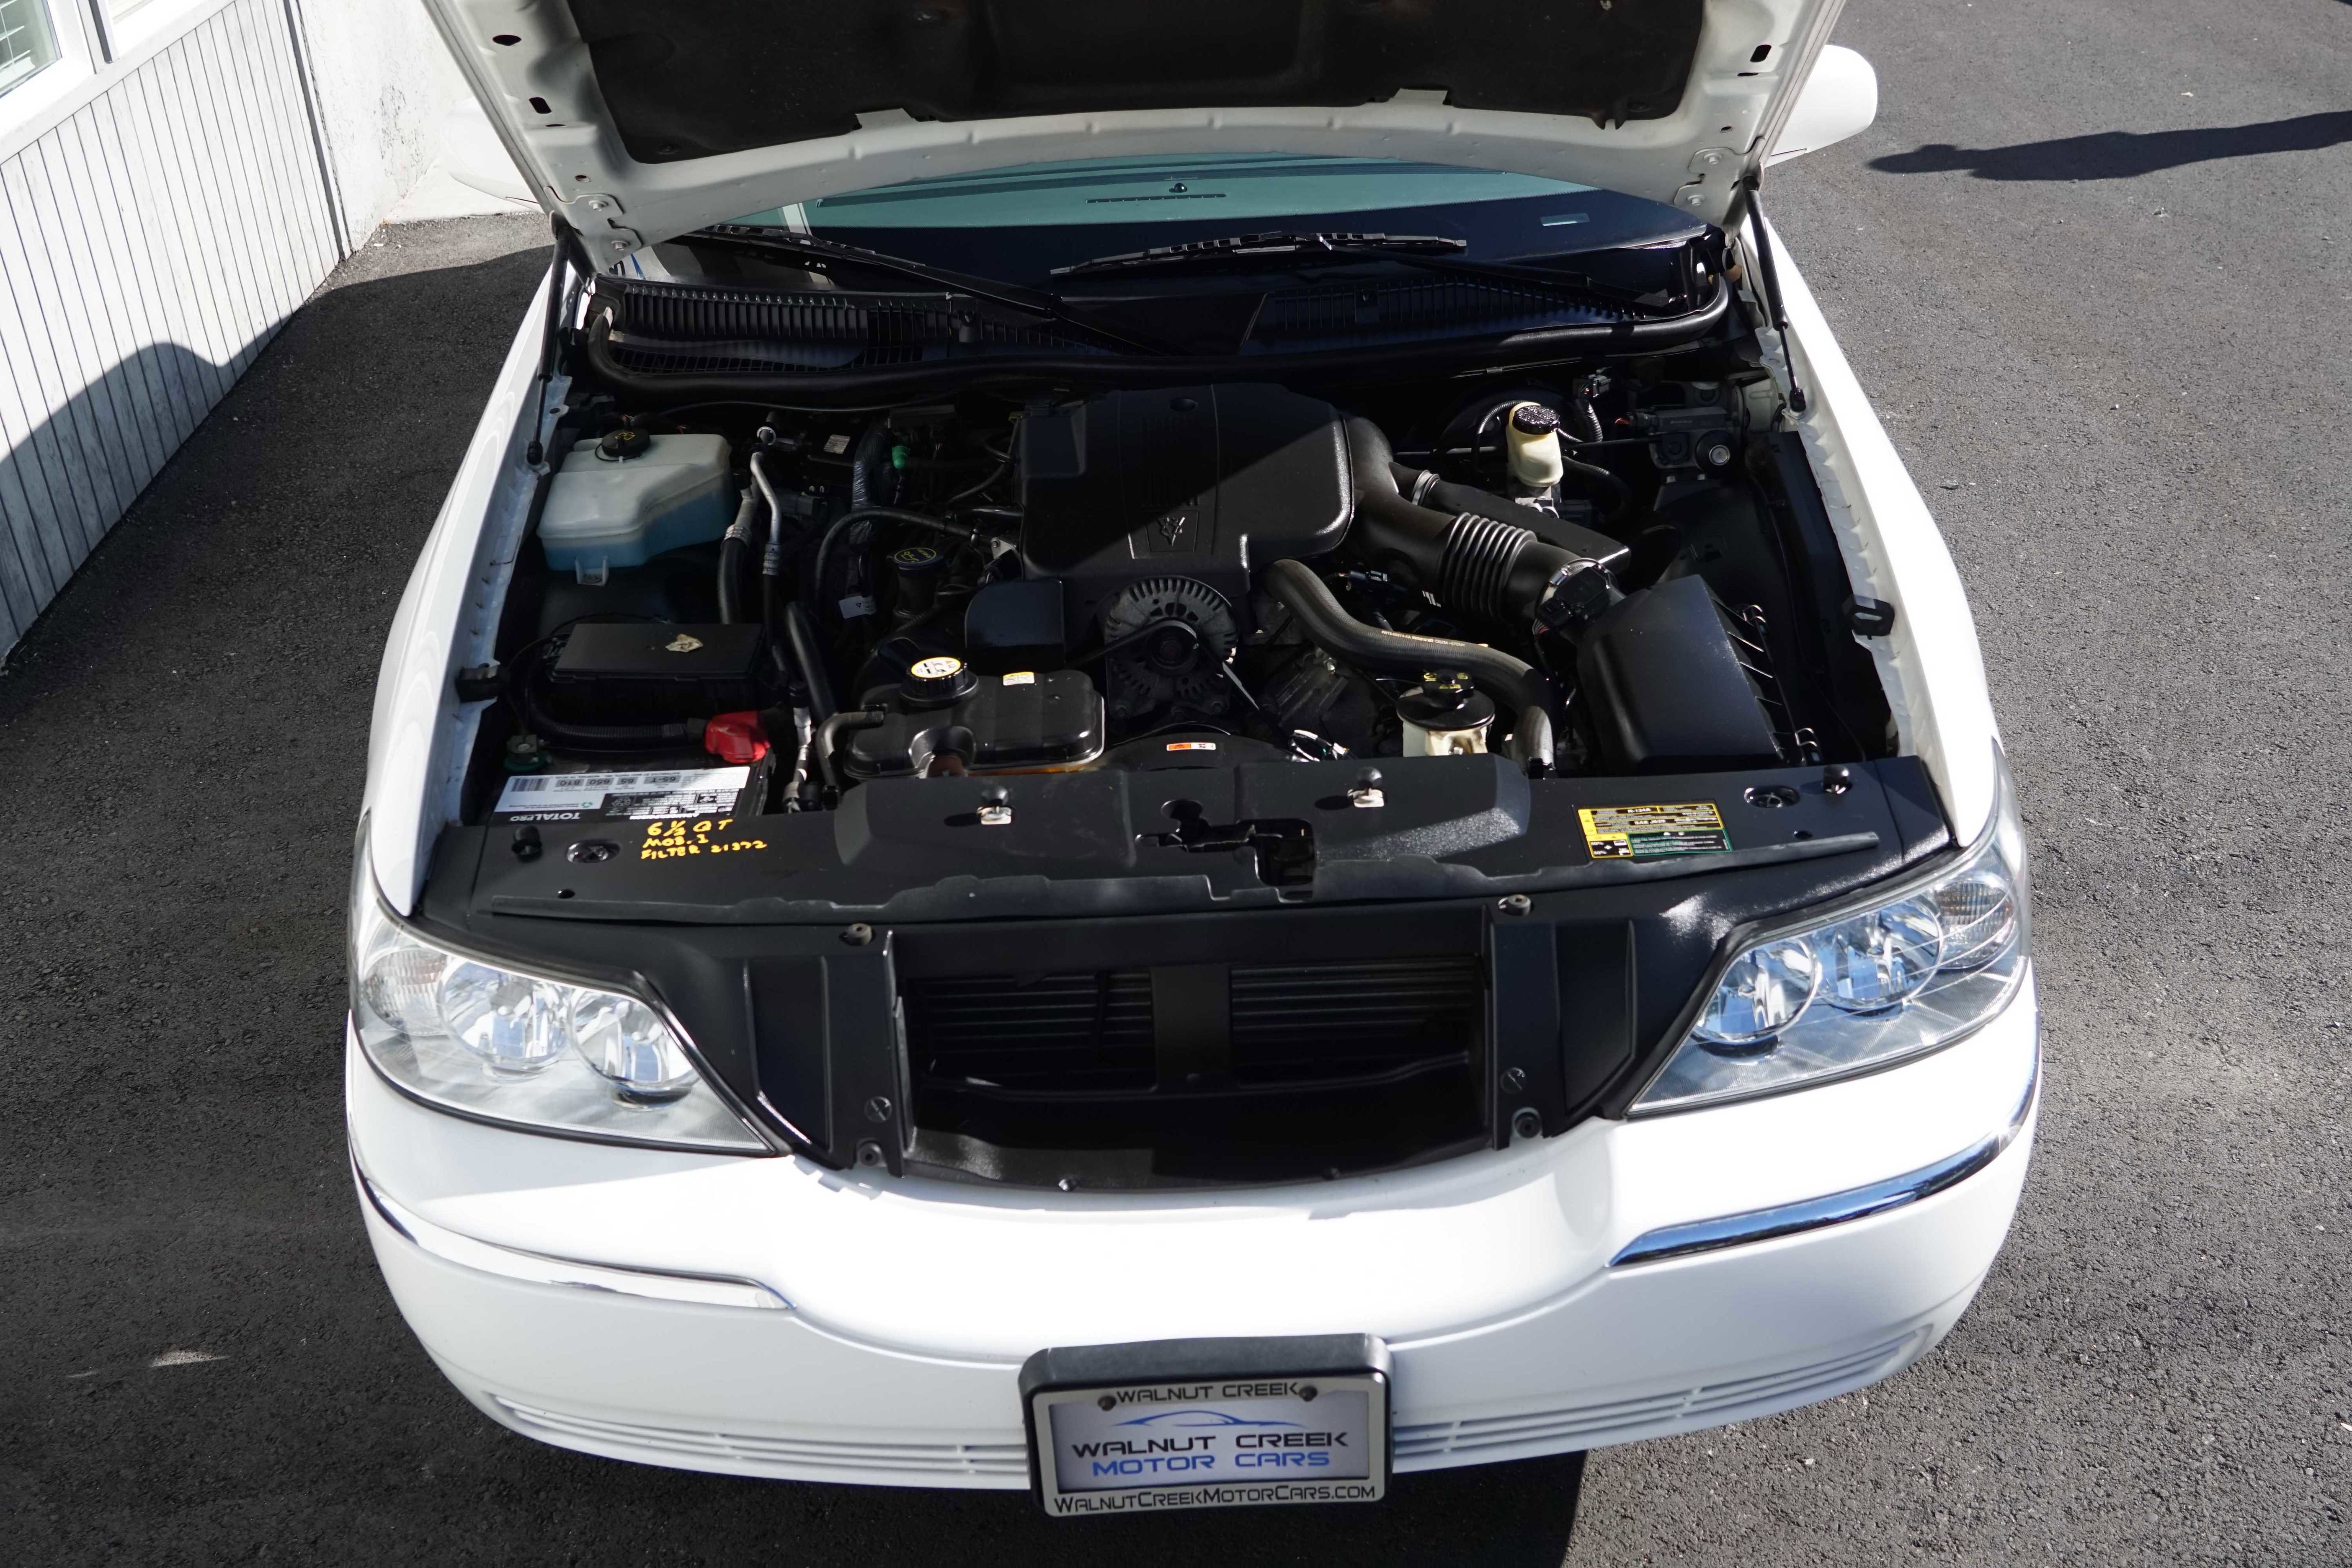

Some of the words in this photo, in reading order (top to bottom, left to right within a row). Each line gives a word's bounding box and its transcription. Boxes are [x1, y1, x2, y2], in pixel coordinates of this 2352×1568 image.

[510, 812, 580, 821] TOTALPRO
[647, 821, 663, 836] 6
[641, 845, 700, 859] FILTER
[1116, 1386, 1213, 1403] WALNUT
[1222, 1383, 1300, 1398] CREEK
[1071, 1435, 1216, 1458] WALNUT
[1236, 1432, 1348, 1449] CREEK
[1092, 1454, 1216, 1476] MOTOR
[1235, 1451, 1330, 1468] CARS
